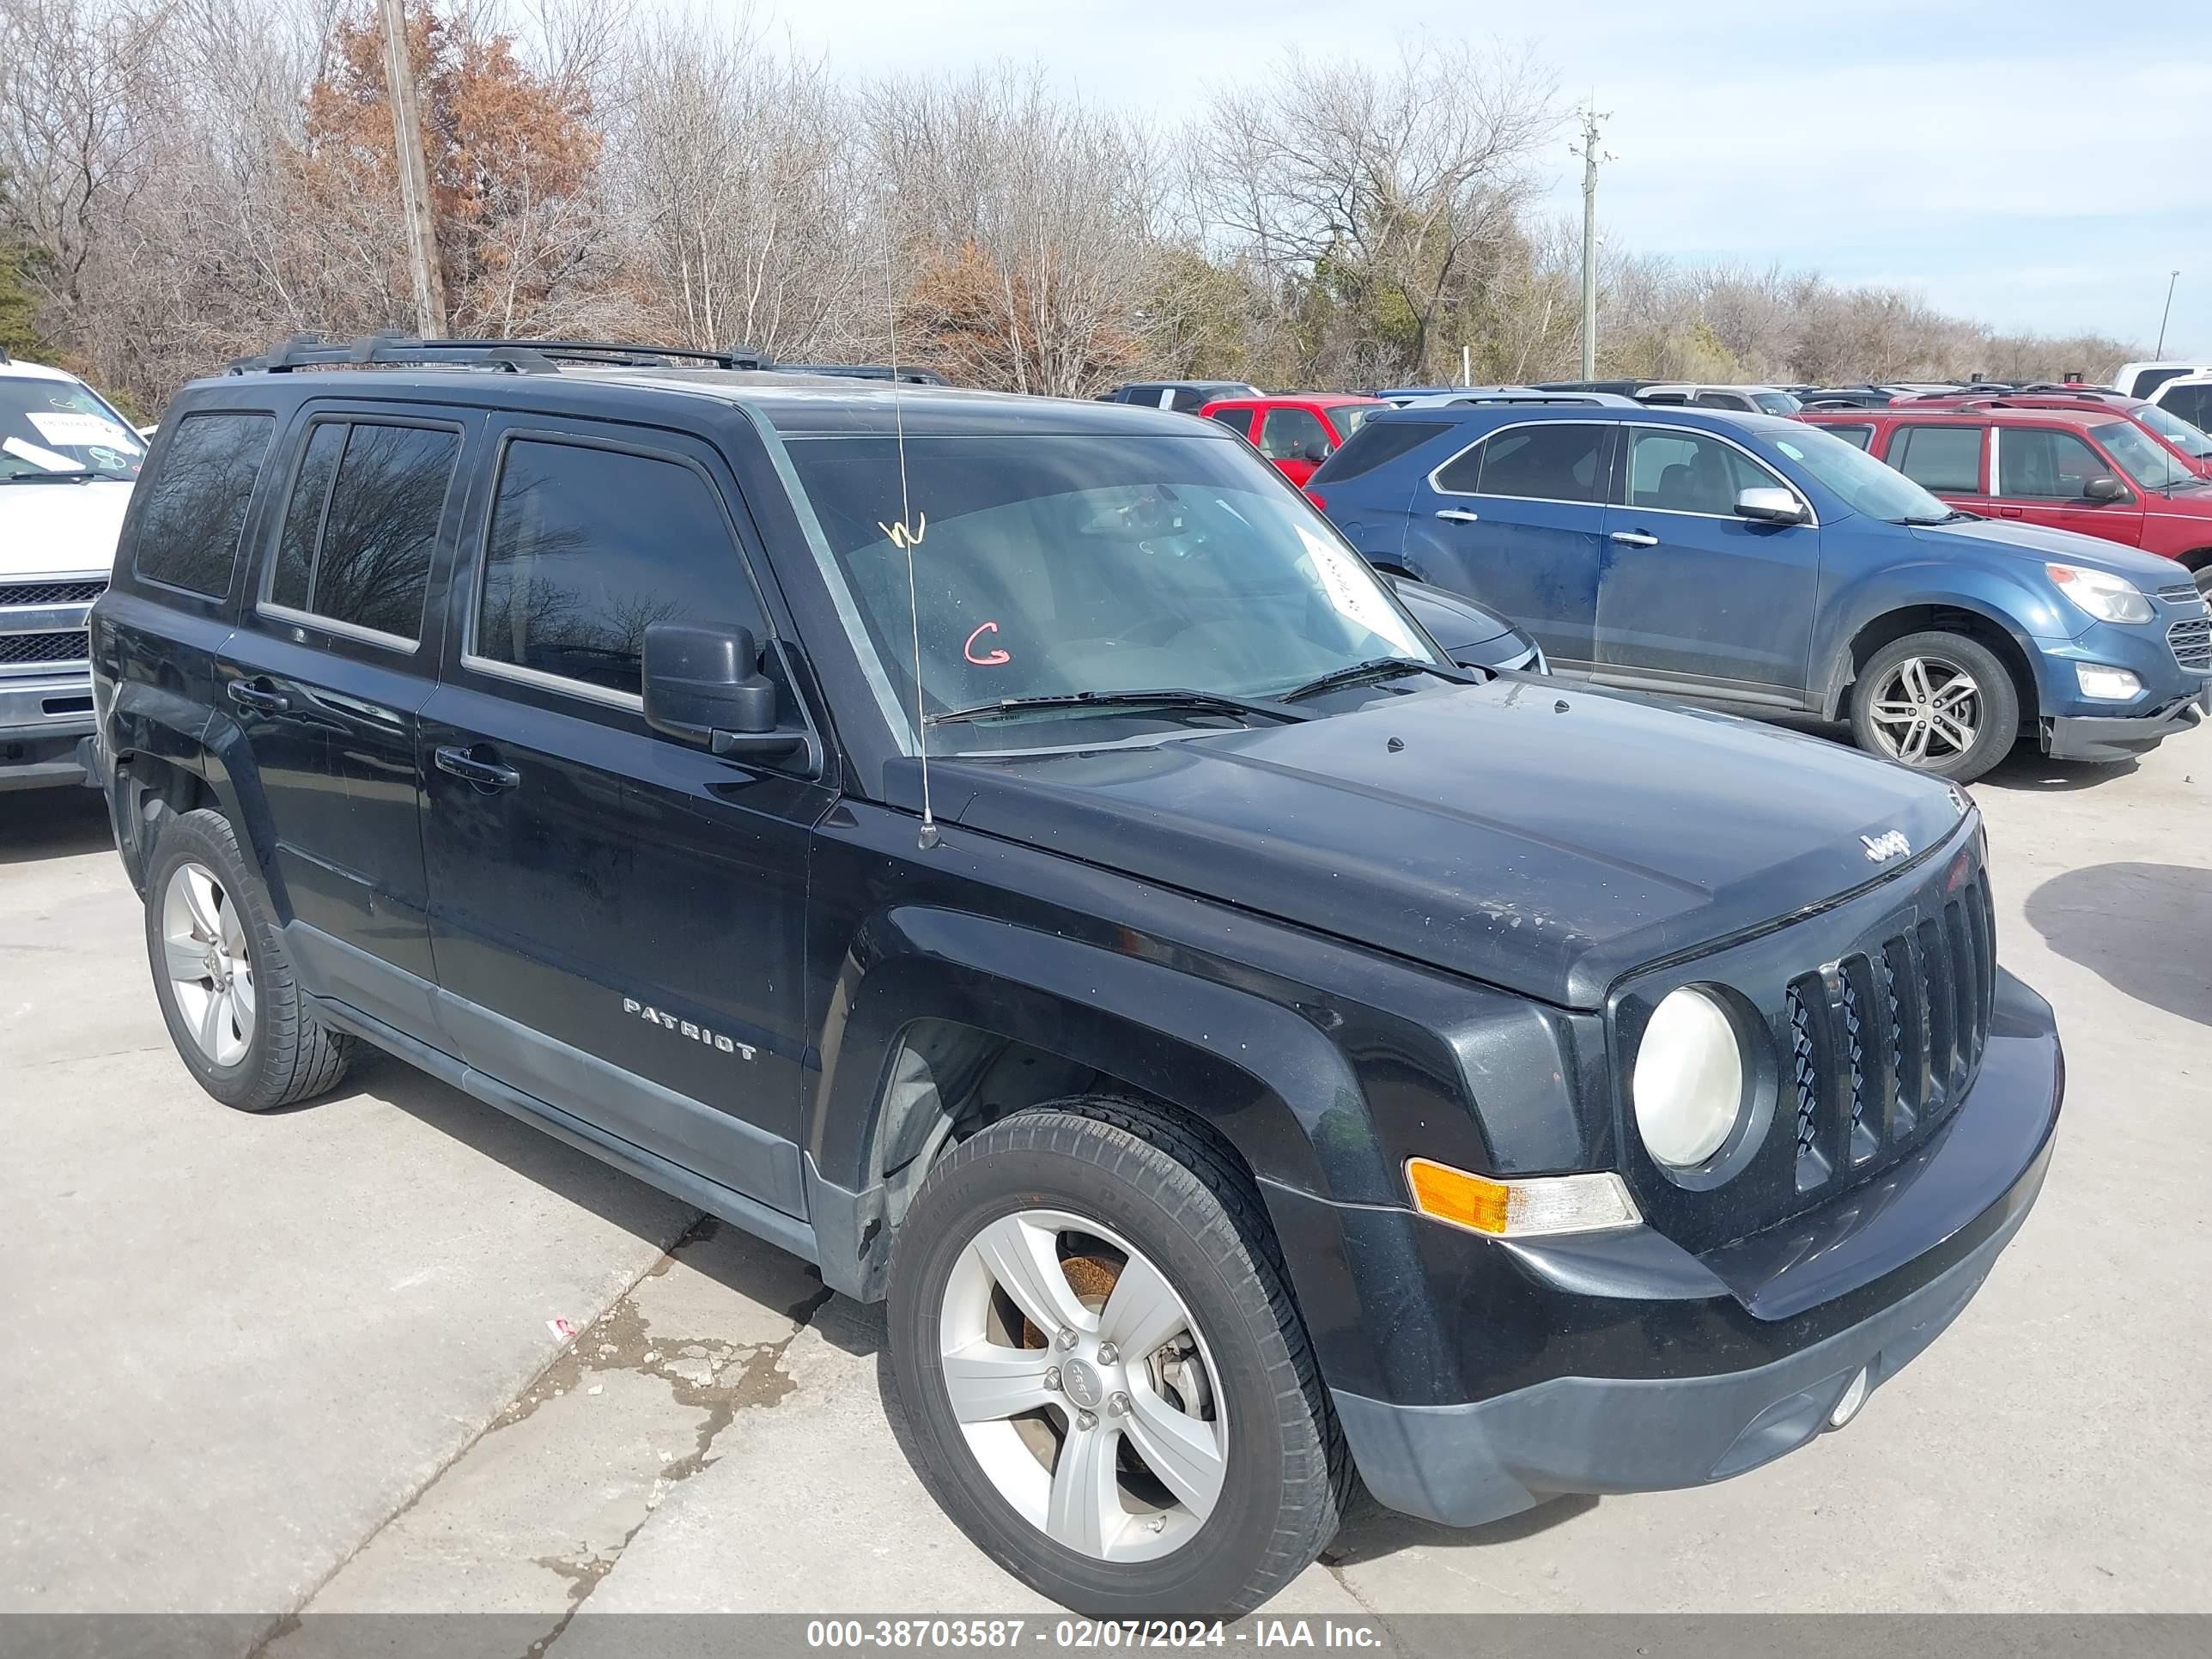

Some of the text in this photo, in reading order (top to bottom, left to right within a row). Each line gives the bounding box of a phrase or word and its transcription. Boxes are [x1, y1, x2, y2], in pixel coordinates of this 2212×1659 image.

[964, 621, 1011, 665] G
[1859, 830, 1911, 863] Jeep
[623, 997, 757, 1060] PATRIOT
[1072, 1364, 1092, 1401] Jeep
